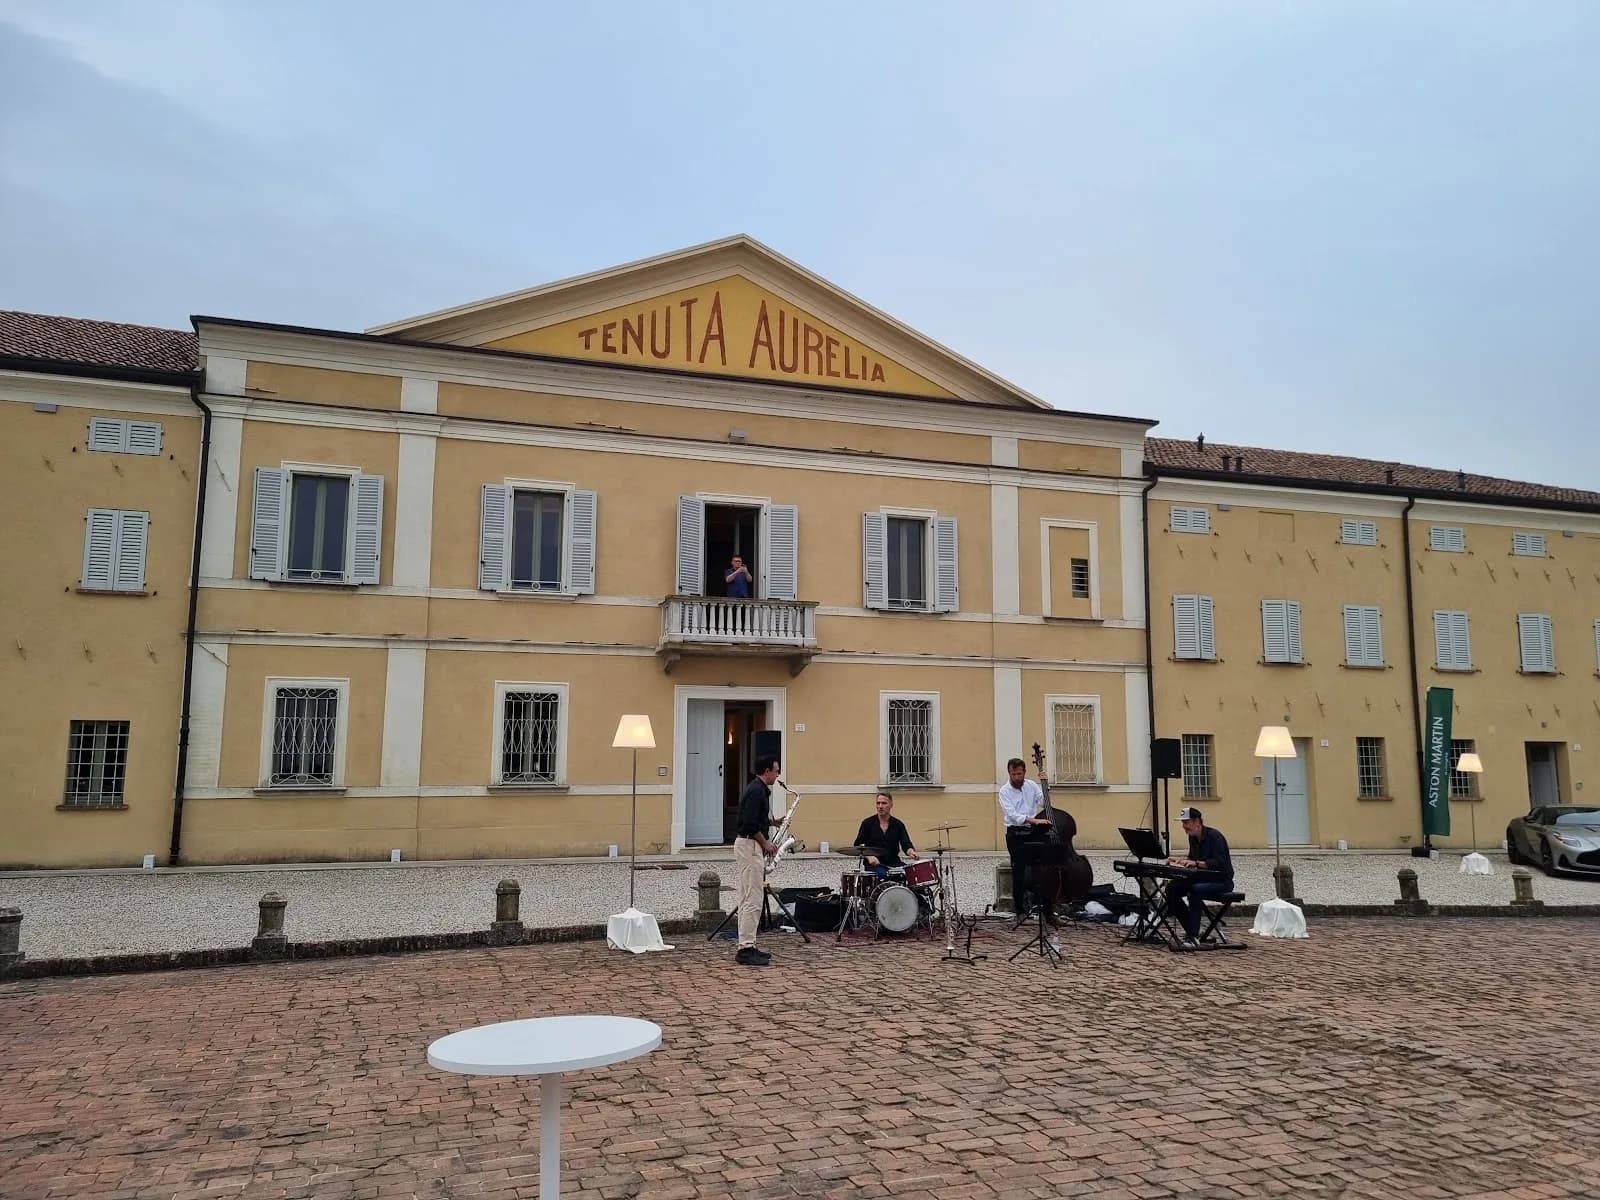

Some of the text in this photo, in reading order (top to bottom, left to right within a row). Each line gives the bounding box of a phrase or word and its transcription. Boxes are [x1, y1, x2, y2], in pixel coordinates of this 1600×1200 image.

[578, 291, 886, 382] TENUTA AURELIA
[1428, 716, 1444, 808] ASTON MARTIN
